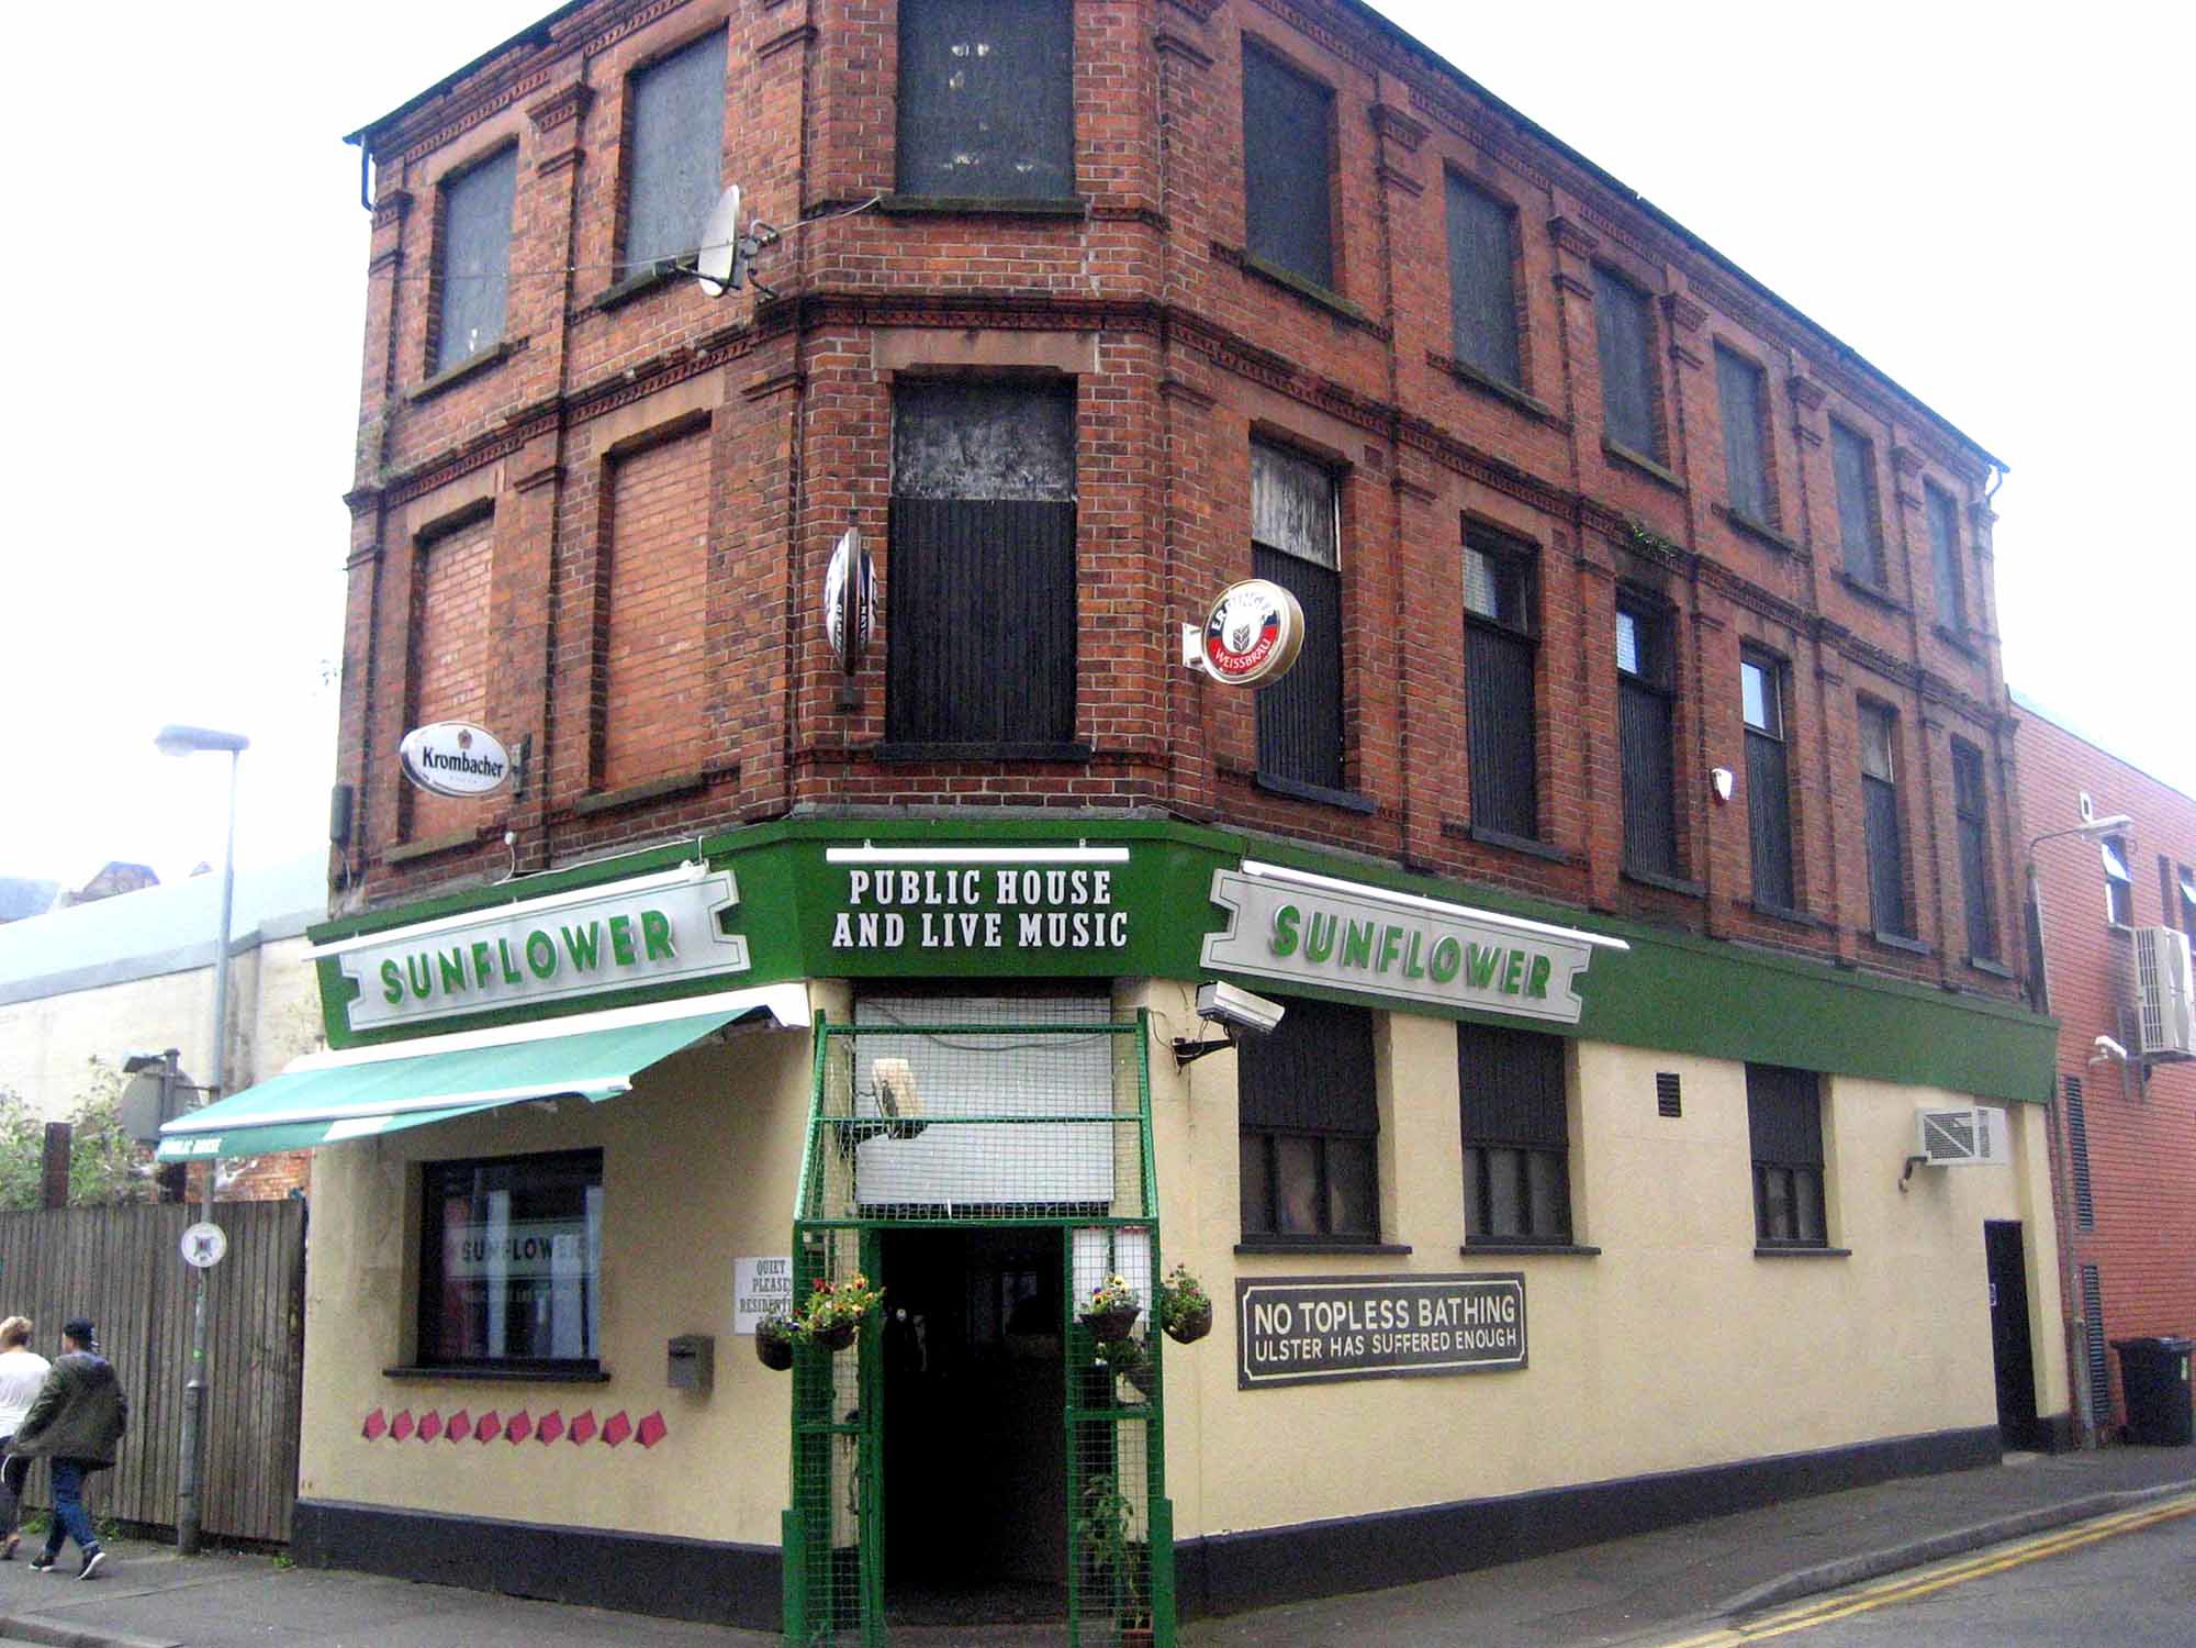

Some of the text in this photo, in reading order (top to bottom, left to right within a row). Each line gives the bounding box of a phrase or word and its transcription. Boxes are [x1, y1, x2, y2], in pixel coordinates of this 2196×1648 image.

[423, 746, 503, 777] Krombacher
[849, 869, 1112, 905] PUBLIC HOUSE
[832, 911, 1129, 948] AND LIVE MUSIC
[379, 909, 676, 1006] SUNFLOWER
[1272, 904, 1551, 998] SUNFLOWER
[757, 1260, 785, 1275] QUIET
[1254, 1295, 1516, 1335] NO TOPLESS BATHING
[1254, 1328, 1517, 1362] ULSTER HAS SUFFERED ENOUGH
